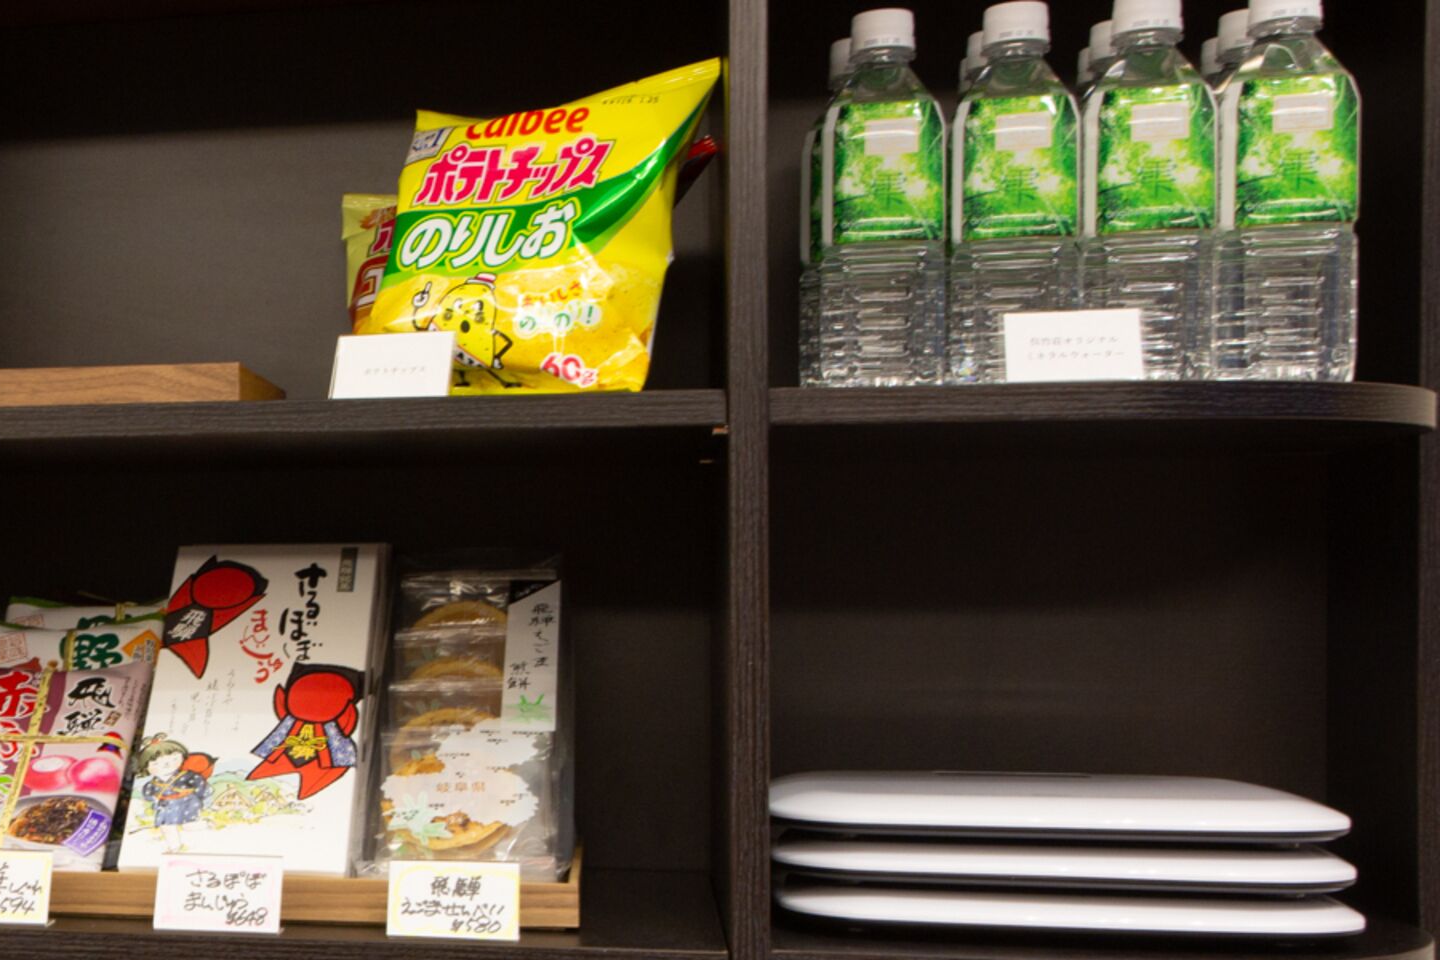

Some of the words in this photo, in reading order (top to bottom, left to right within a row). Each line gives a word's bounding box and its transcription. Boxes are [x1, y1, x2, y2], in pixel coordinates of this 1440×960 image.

[414, 138, 611, 204] ポテトチップス
[401, 202, 577, 268] のりしお
[278, 562, 328, 661] さるぼぼ
